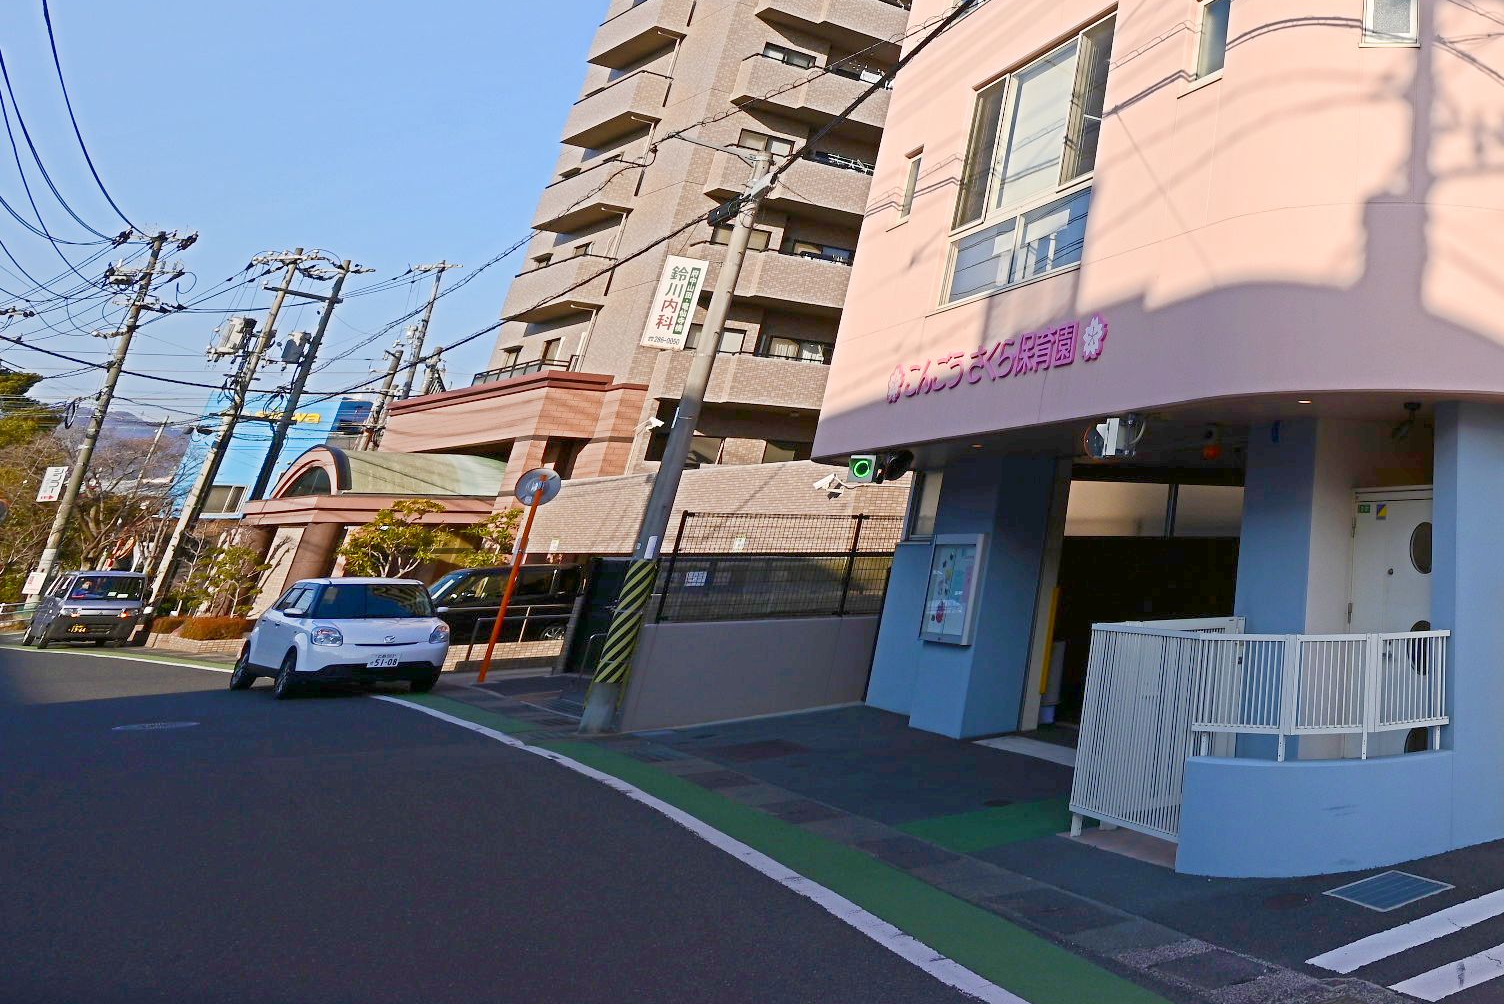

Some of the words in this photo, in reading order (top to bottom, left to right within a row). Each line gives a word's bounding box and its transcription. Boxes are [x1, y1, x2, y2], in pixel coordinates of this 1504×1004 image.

[655, 265, 689, 331] 鈴川内科
[905, 320, 1080, 398] こんごうさくら保育園
